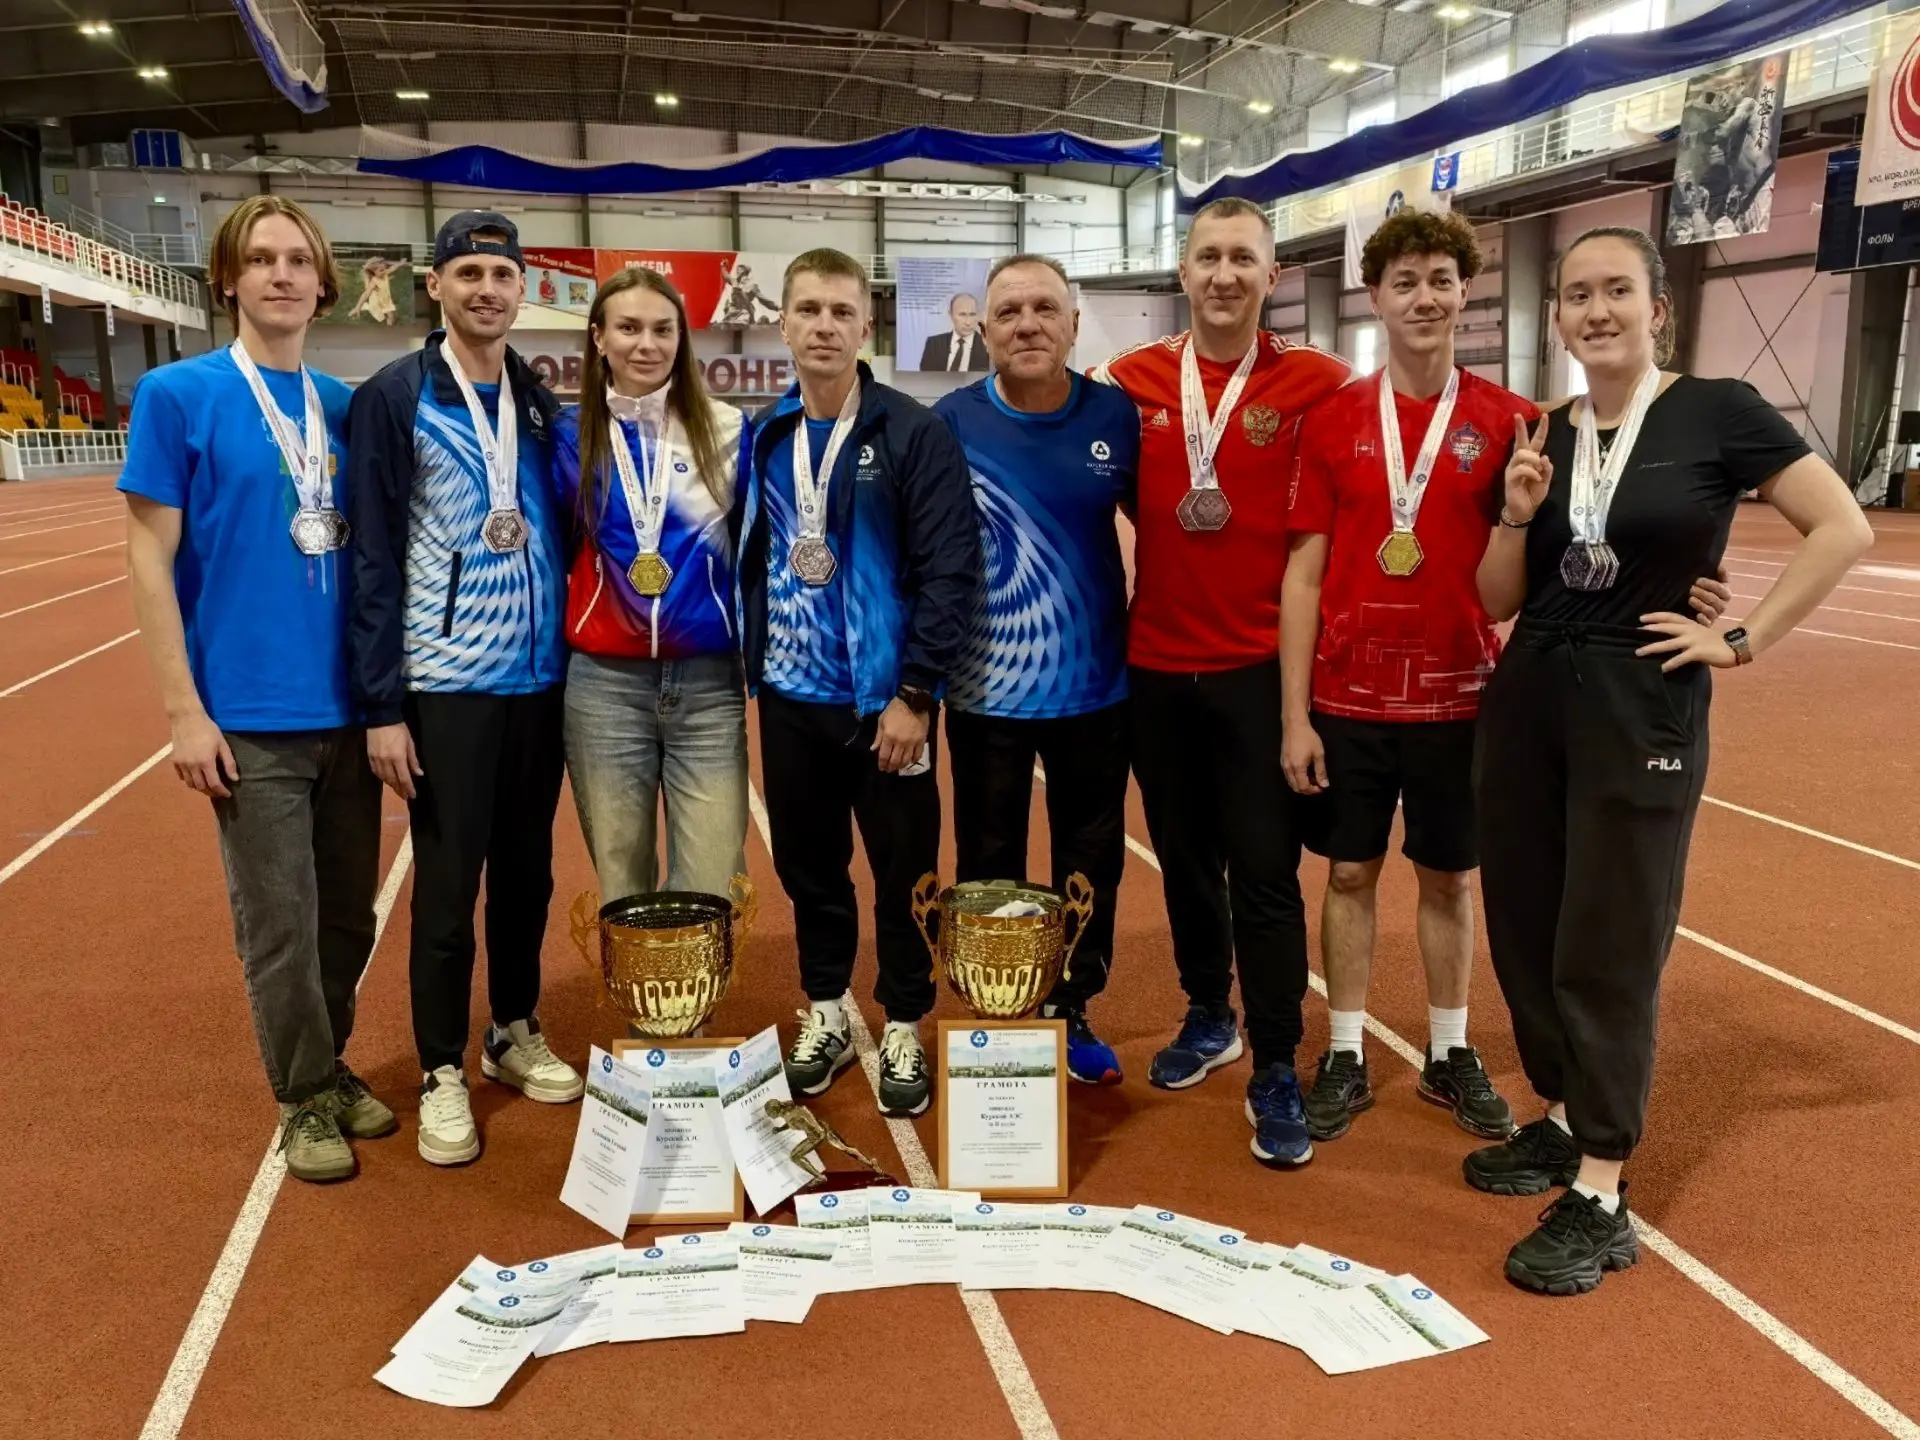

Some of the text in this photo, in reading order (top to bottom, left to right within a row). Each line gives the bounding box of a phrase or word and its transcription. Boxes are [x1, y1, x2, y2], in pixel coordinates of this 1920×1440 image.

[1884, 169, 1909, 181] WORLD
[1867, 233, 1894, 245] ФОЛЫ
[1647, 757, 1682, 771] FILA
[976, 1081, 1027, 1089] ГРАМОТА
[652, 1101, 705, 1110] ГРАМОТА
[743, 1255, 797, 1265] ГРАМОТА
[649, 1274, 706, 1283] ГРАМОТА
